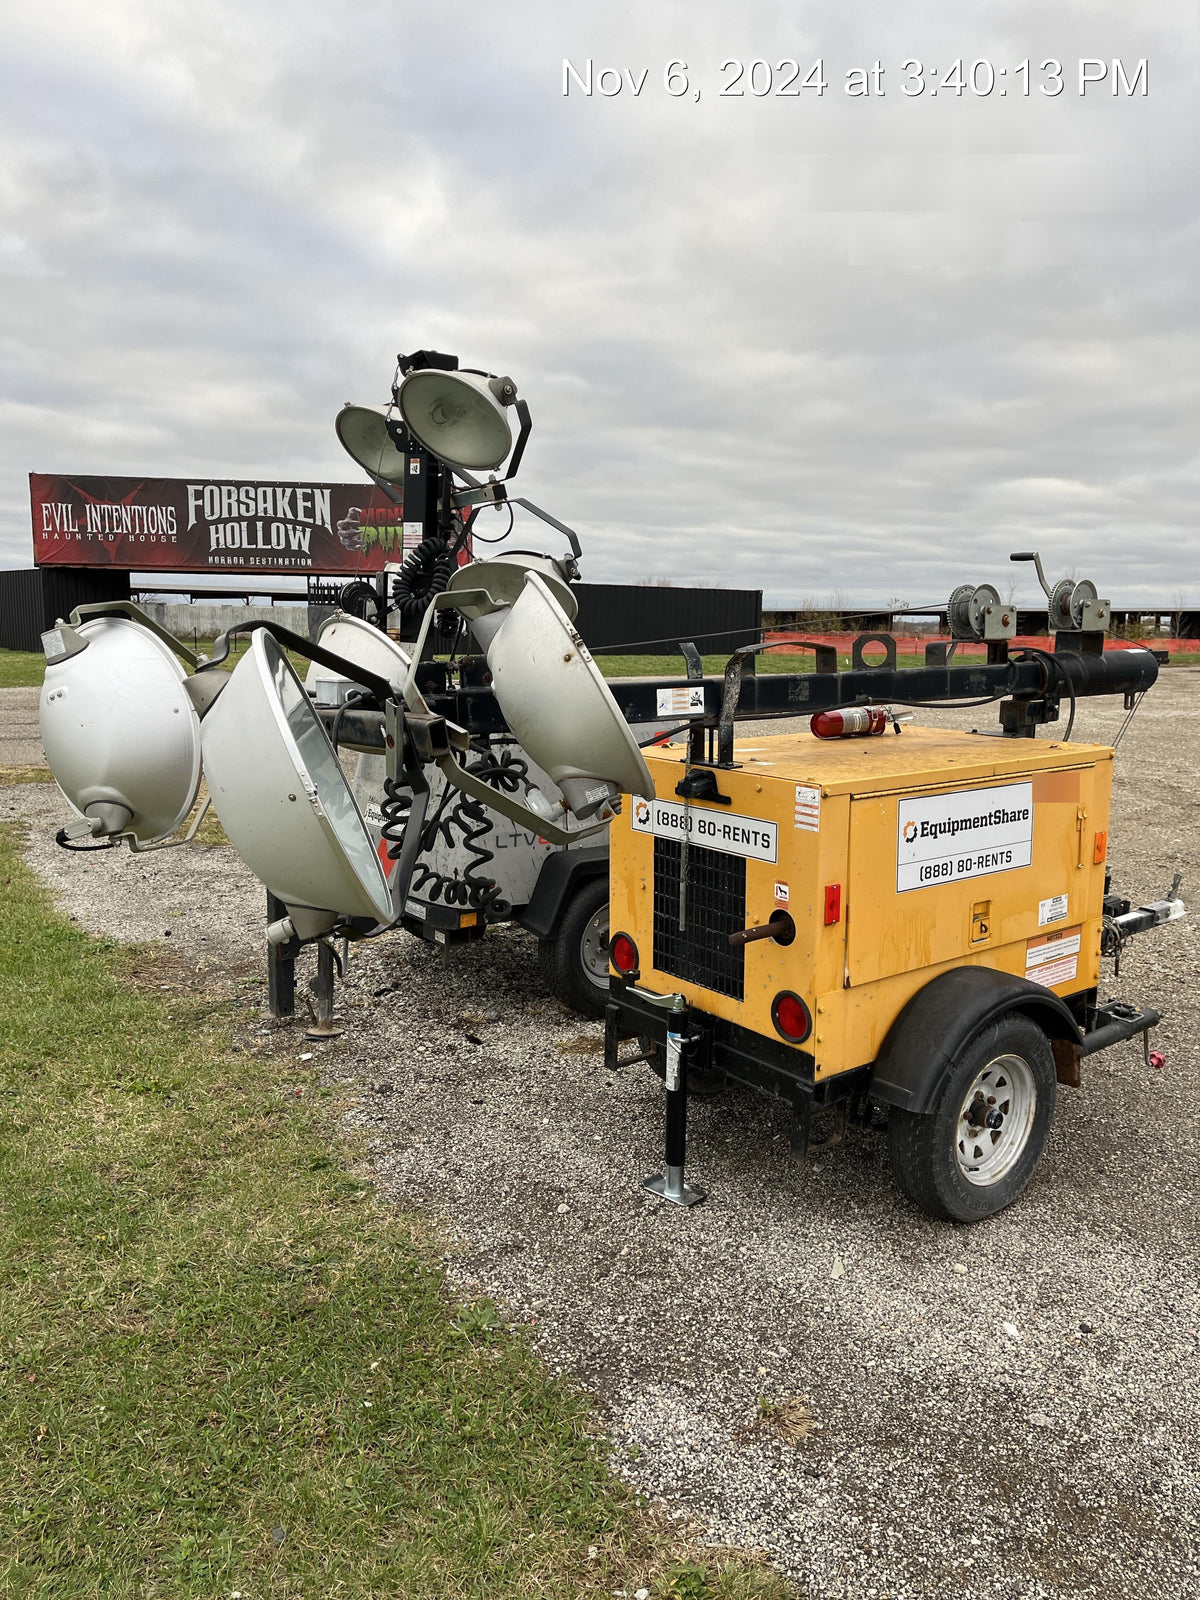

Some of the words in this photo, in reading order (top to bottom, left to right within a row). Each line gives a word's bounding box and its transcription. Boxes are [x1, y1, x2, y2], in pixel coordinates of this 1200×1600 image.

[41, 503, 79, 532] EVIL
[85, 502, 177, 535] INTENTIONS
[186, 485, 333, 535] FORSAKEN
[42, 533, 115, 541] HAUNTED
[129, 534, 177, 542] HOUSE
[209, 521, 312, 555] HOLLOW
[208, 555, 246, 565] HORROR
[250, 557, 312, 566] DESTINATION
[698, 819, 771, 849] 80-RENTS
[920, 809, 1029, 839] EquipmentShare
[919, 860, 953, 881] (888)
[957, 850, 1012, 873] 80-RENTS
